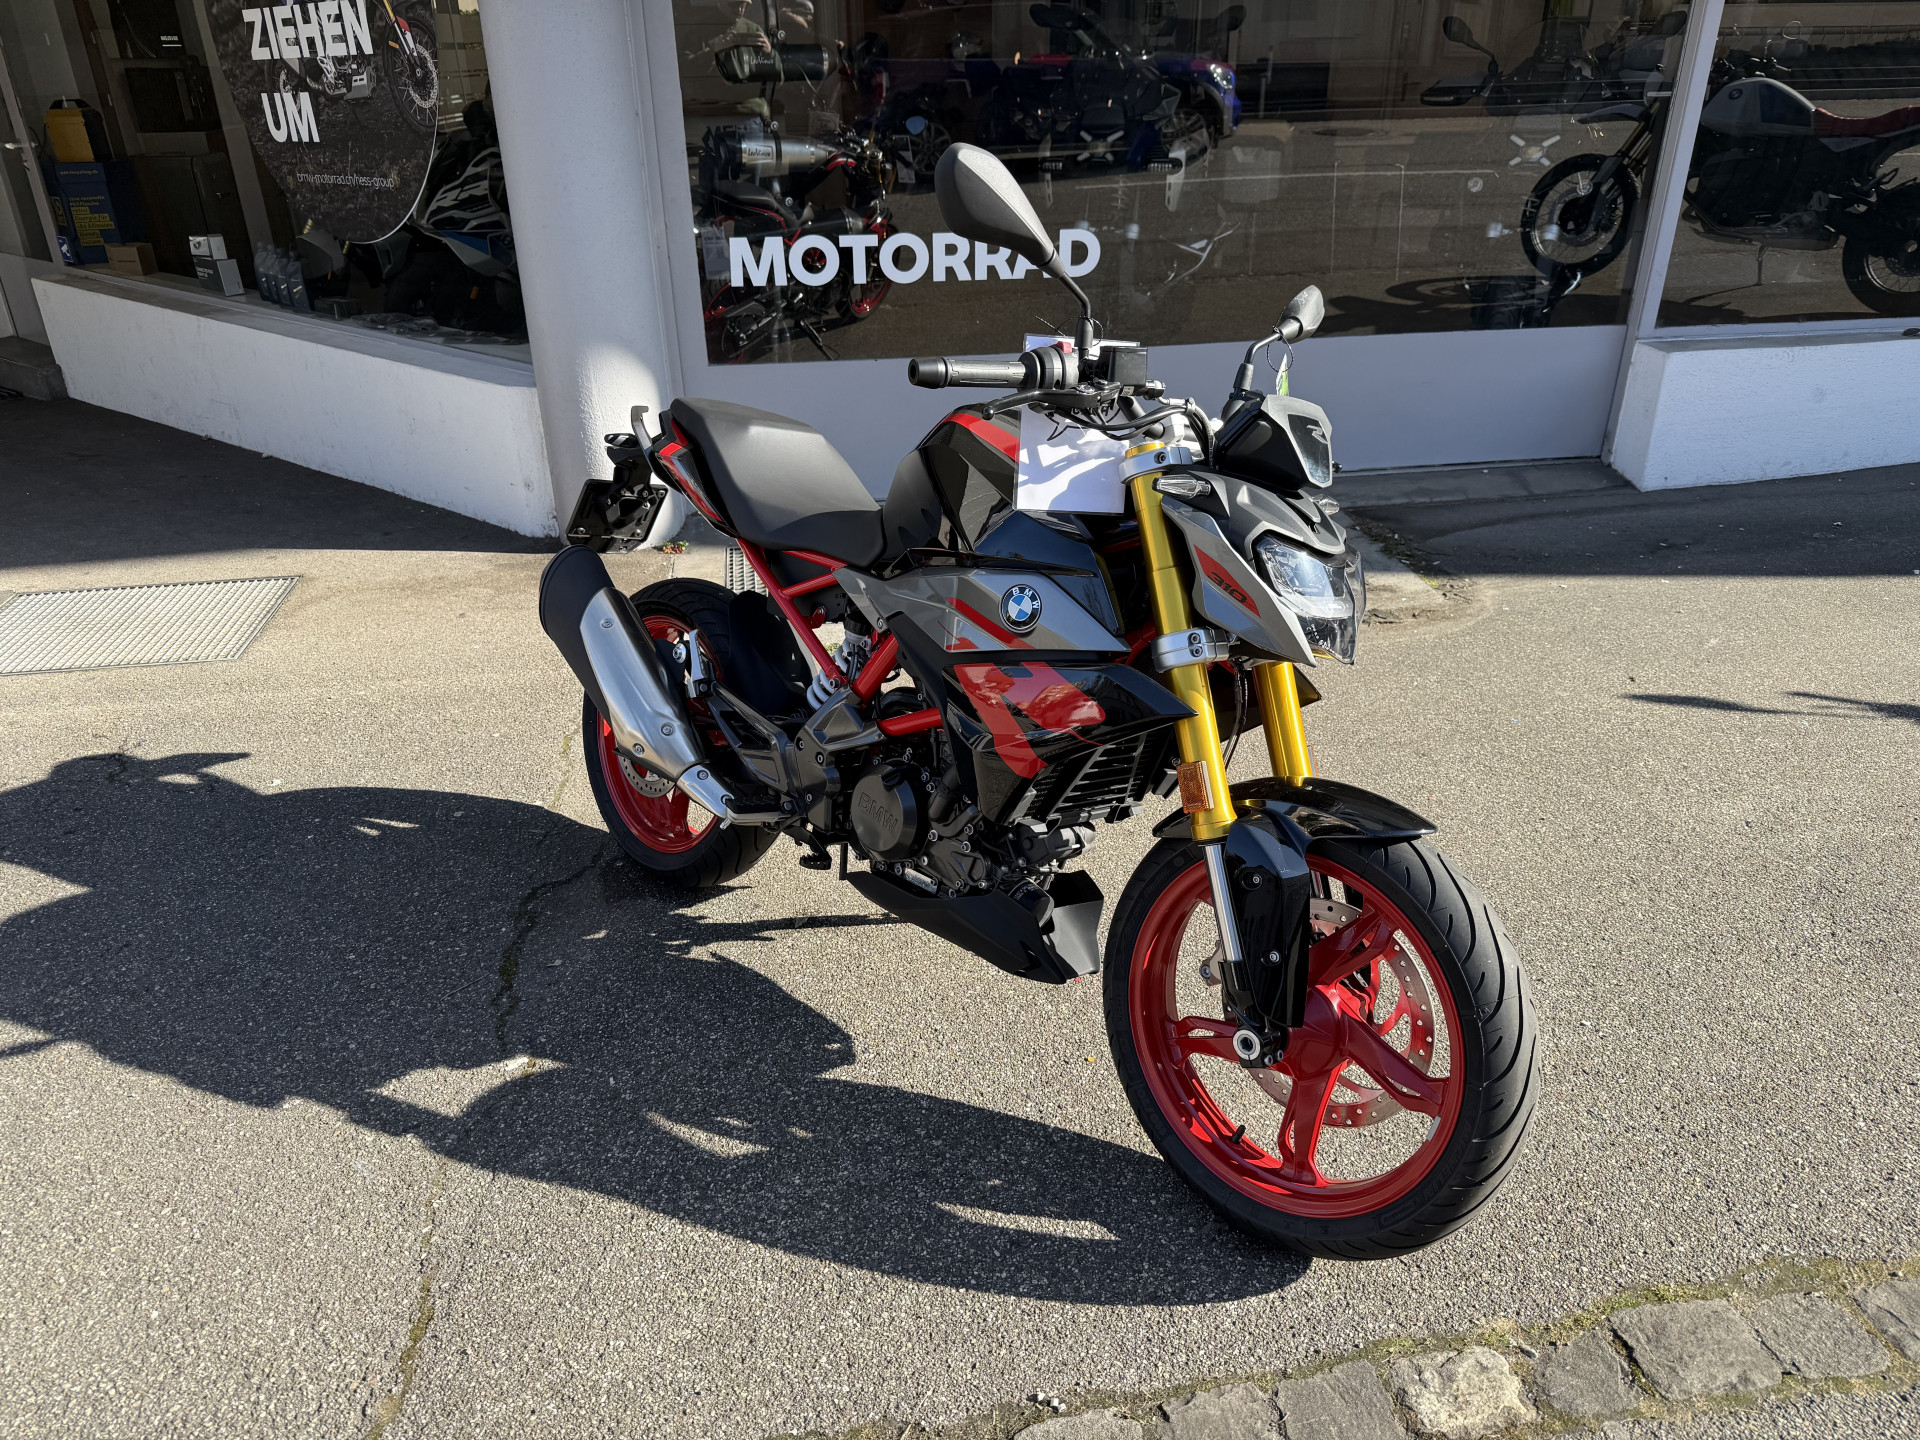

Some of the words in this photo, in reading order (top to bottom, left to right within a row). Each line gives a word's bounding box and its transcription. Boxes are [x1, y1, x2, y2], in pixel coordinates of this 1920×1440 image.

[242, 0, 375, 61] ZIEHEN
[260, 91, 320, 144] UM
[1012, 586, 1040, 609] BMW
[1207, 571, 1247, 604] 310
[858, 791, 899, 833] BMW
